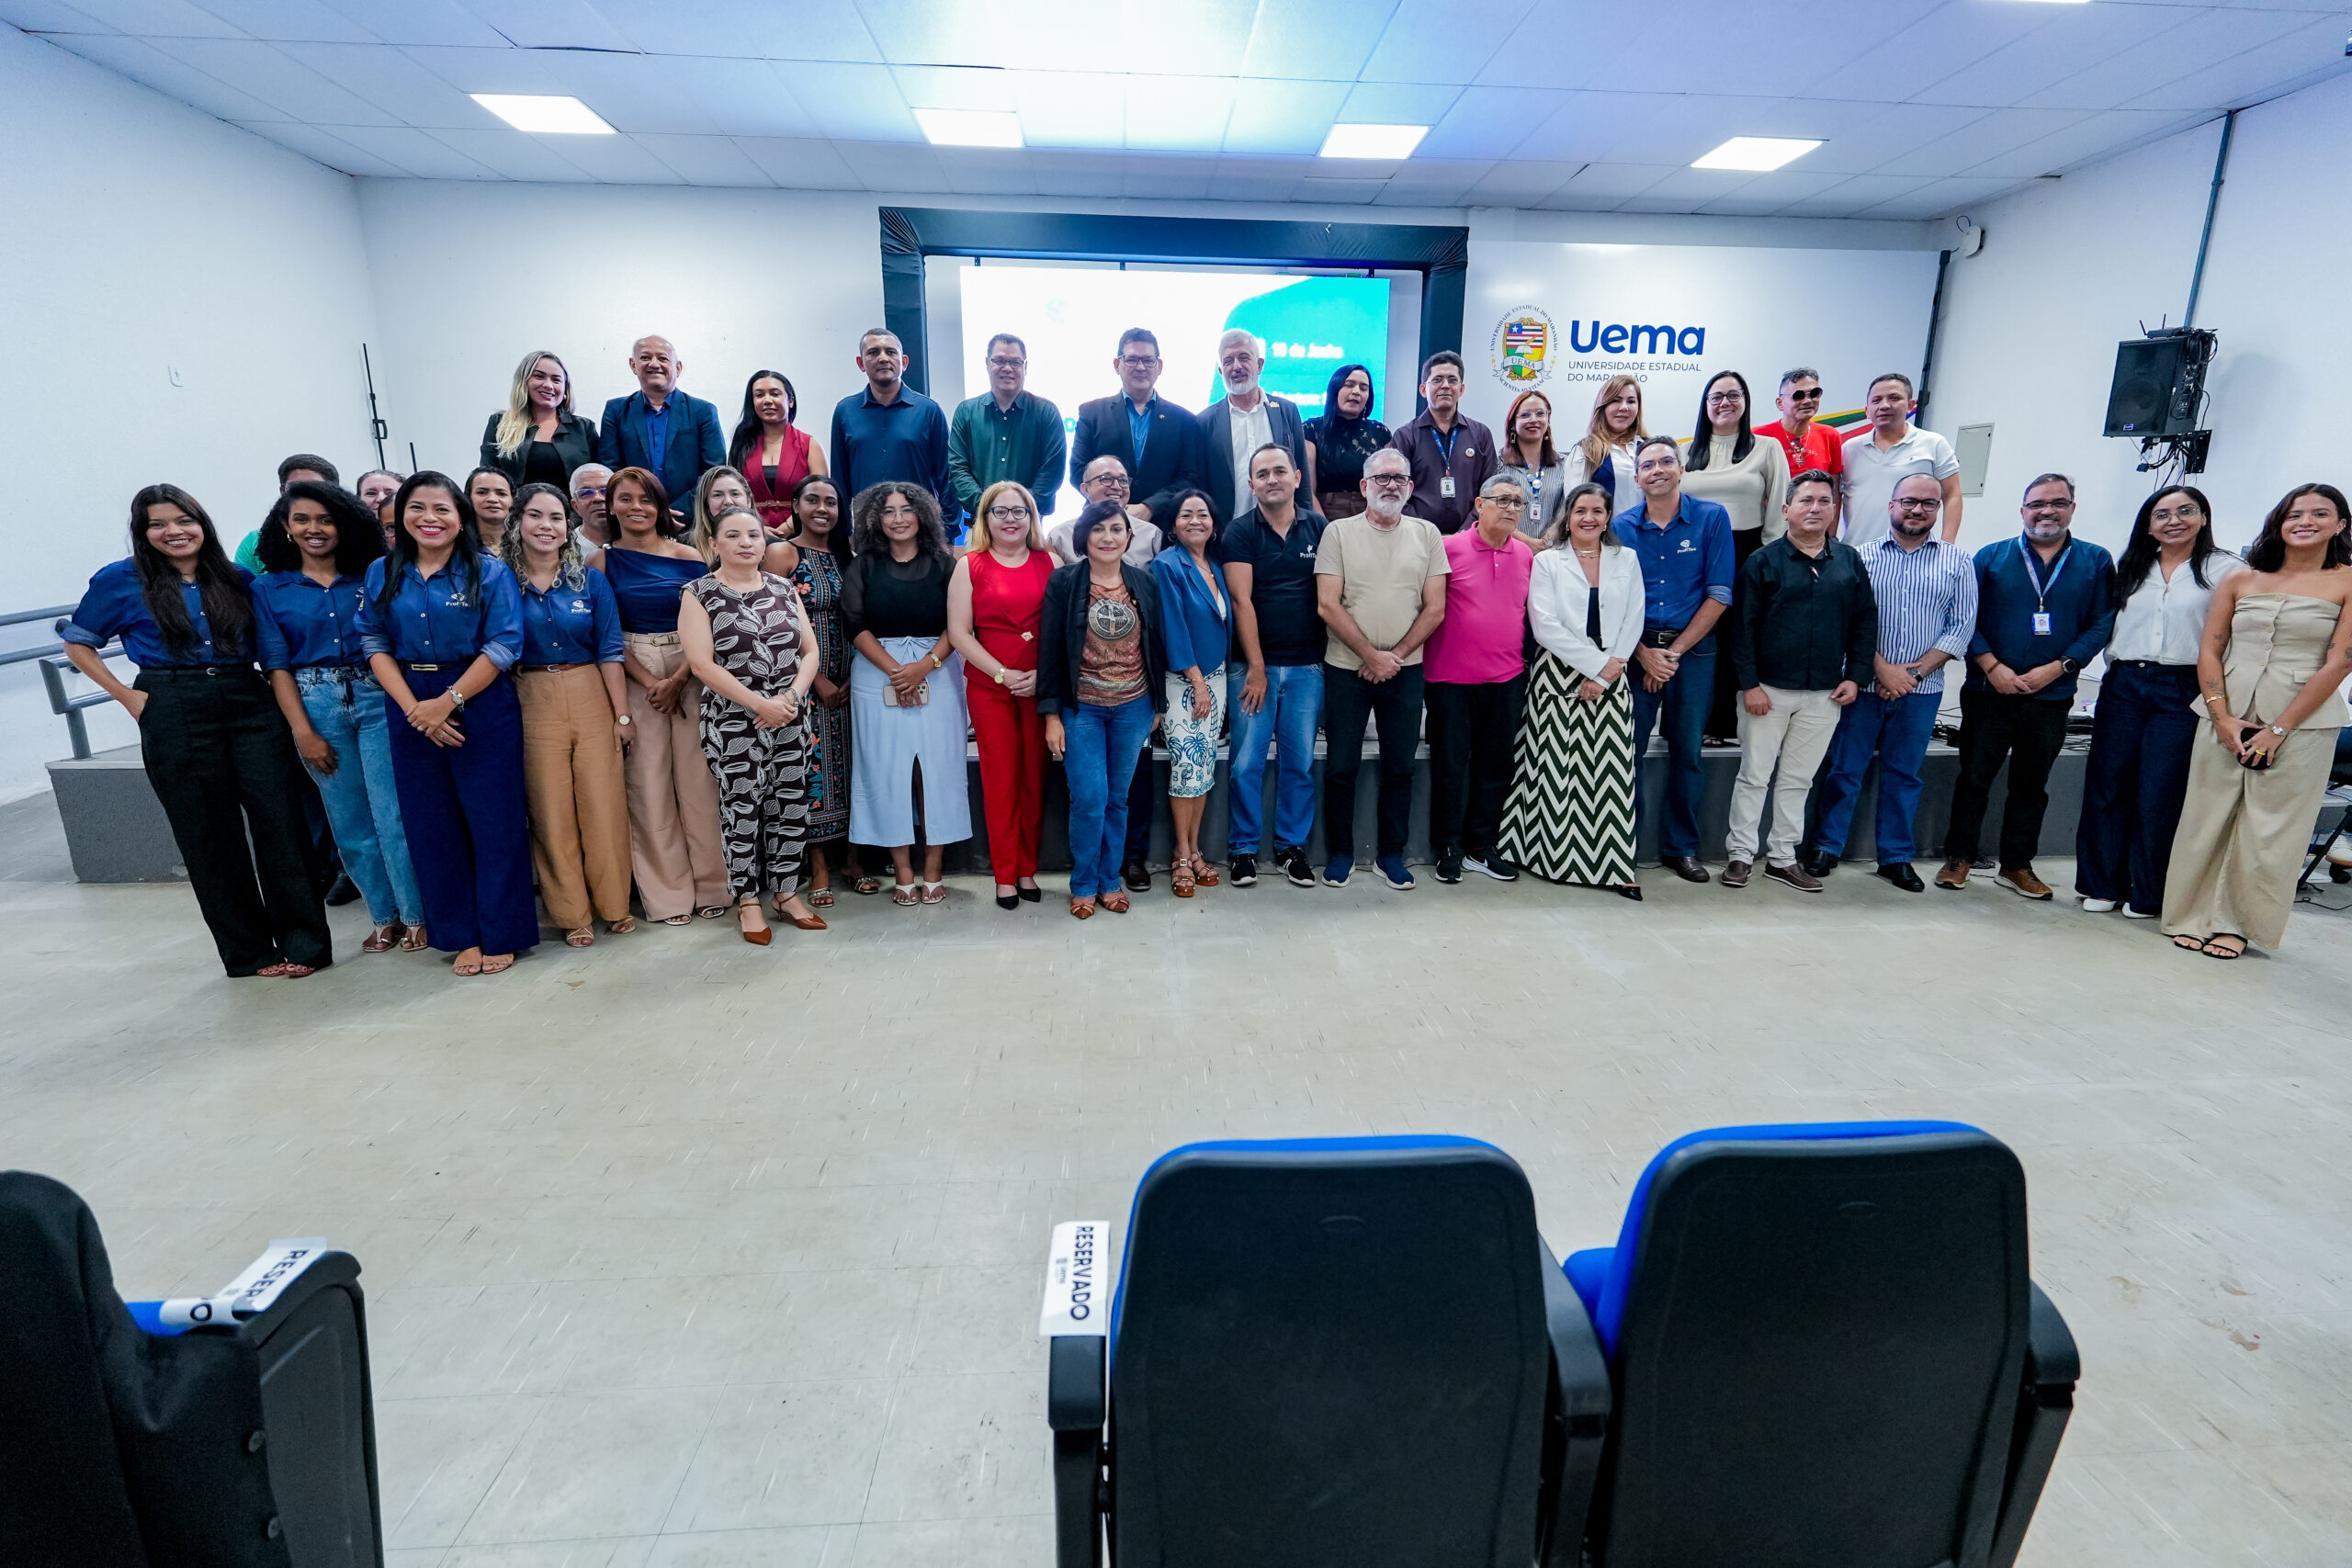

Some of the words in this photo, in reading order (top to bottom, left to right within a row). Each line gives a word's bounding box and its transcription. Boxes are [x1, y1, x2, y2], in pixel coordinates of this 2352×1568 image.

[1490, 311, 1512, 351] UNIVERSIDADE
[1570, 320, 1705, 355] Uema
[1511, 357, 1535, 368] UEMA
[1568, 361, 1645, 371] UNIVERSIDADE
[1648, 362, 1702, 372] ESTADUAL
[1567, 373, 1584, 382] DO
[1070, 1226, 1093, 1320] RESERVADO
